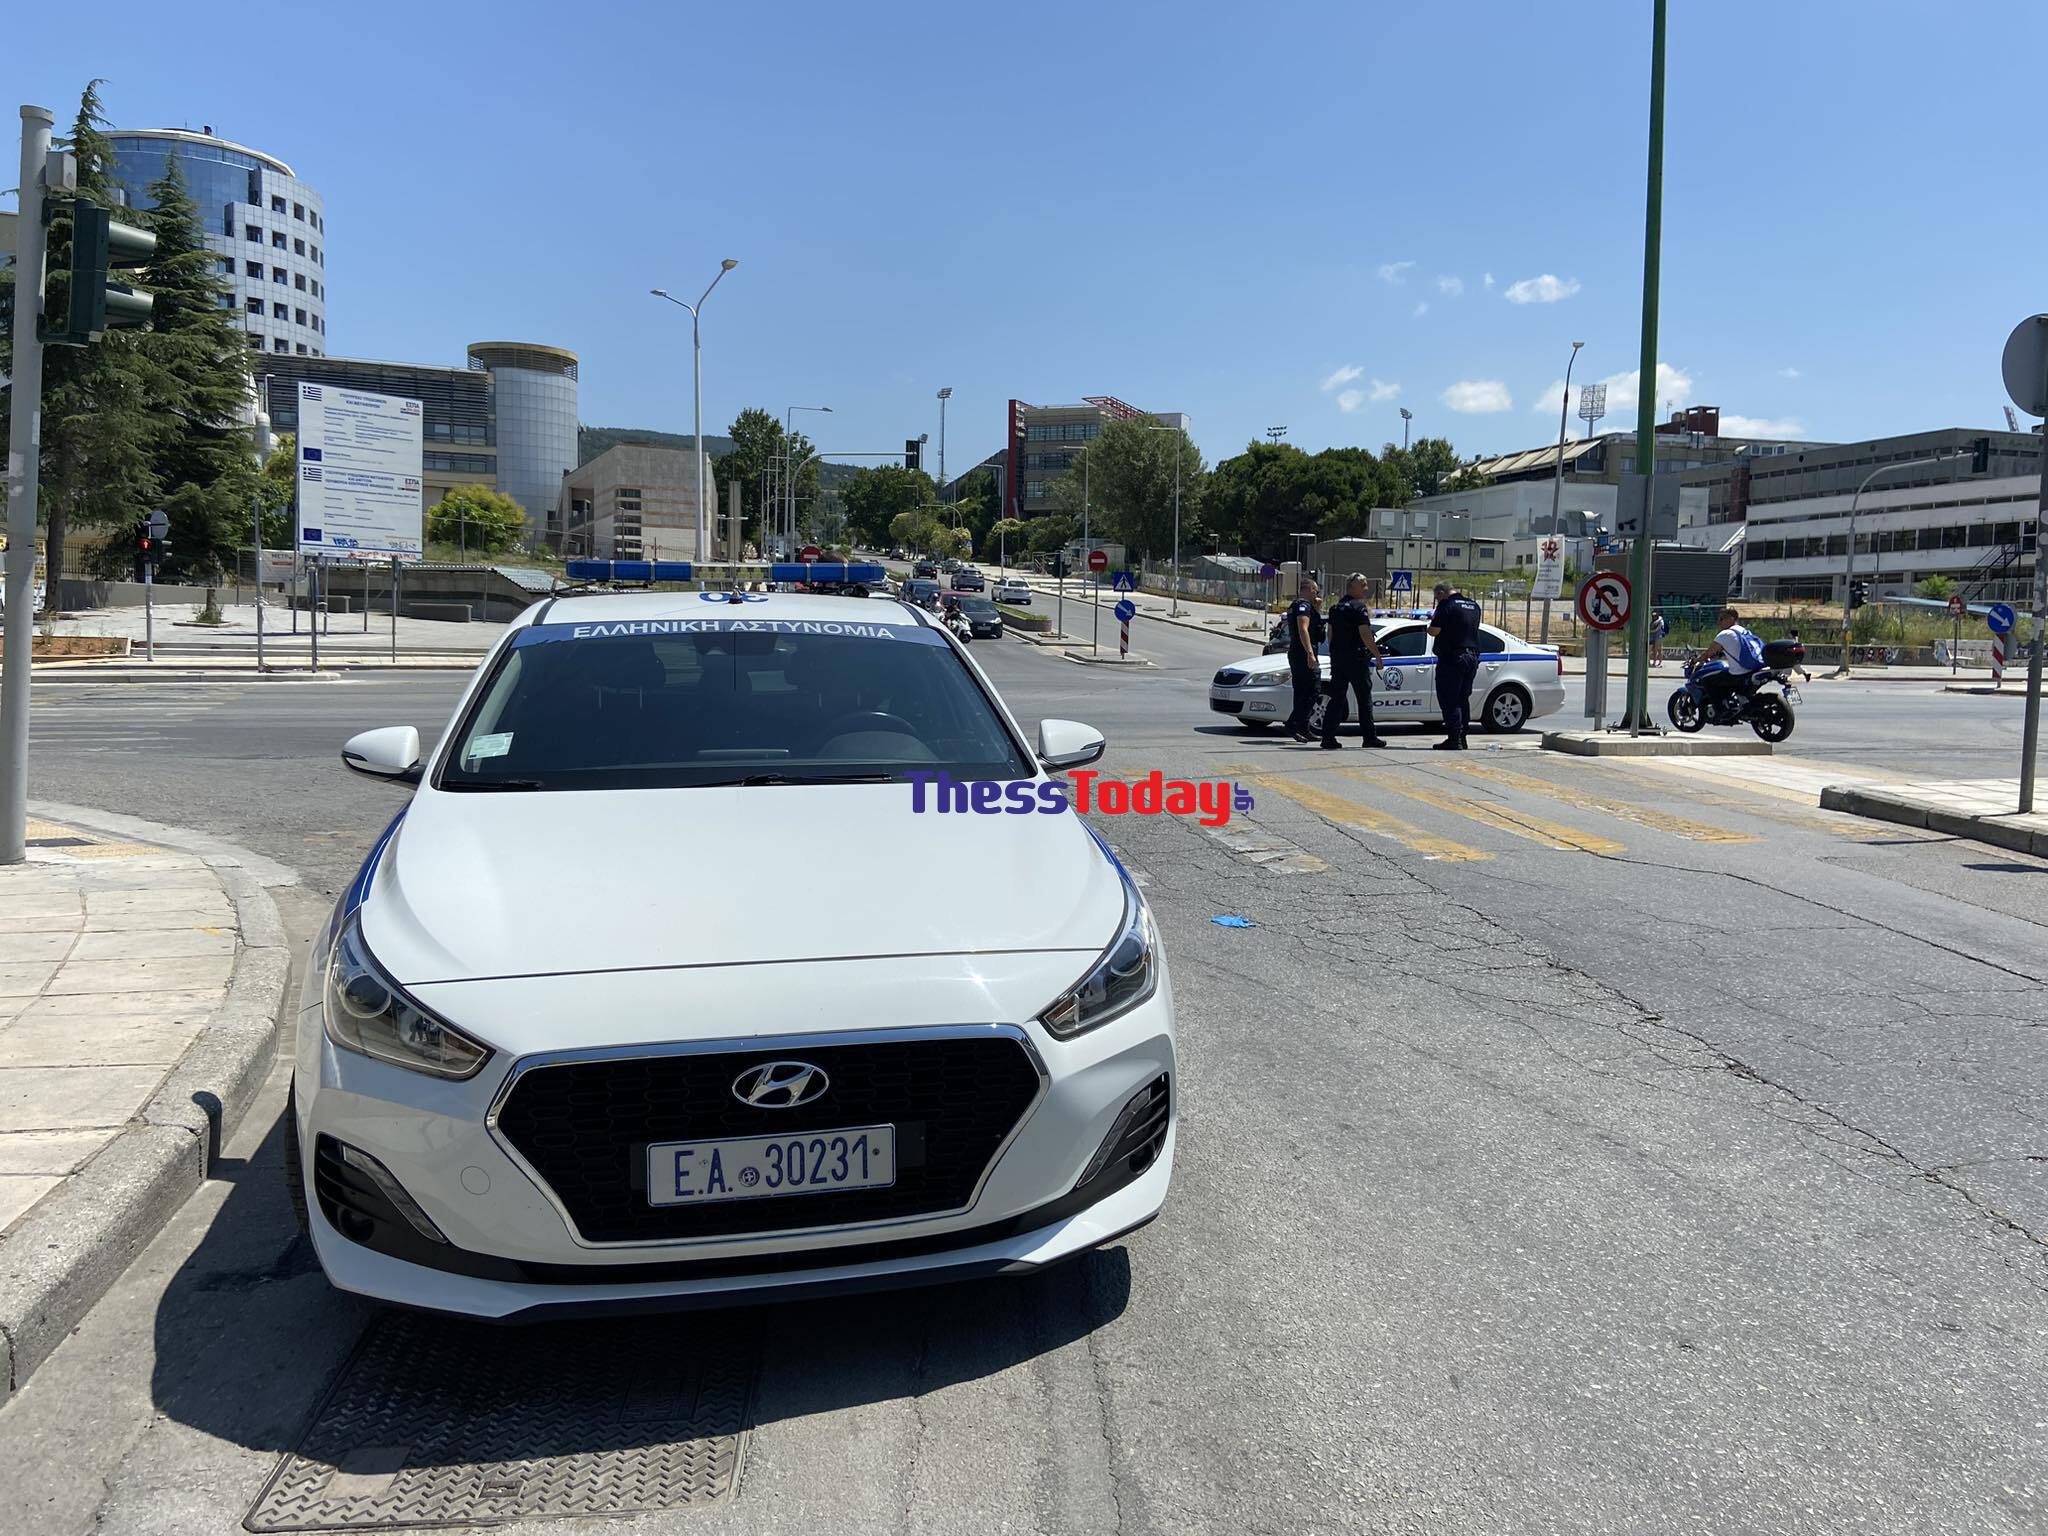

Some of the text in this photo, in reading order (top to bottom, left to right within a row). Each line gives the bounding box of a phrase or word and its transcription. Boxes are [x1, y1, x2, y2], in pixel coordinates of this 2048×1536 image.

[573, 620, 896, 639] ΕΛΛΗΝΙΚΗ ΑΣΤΥΝΟΜΙΑ
[1372, 698, 1423, 707] OLICE
[765, 1134, 868, 1188] 30231
